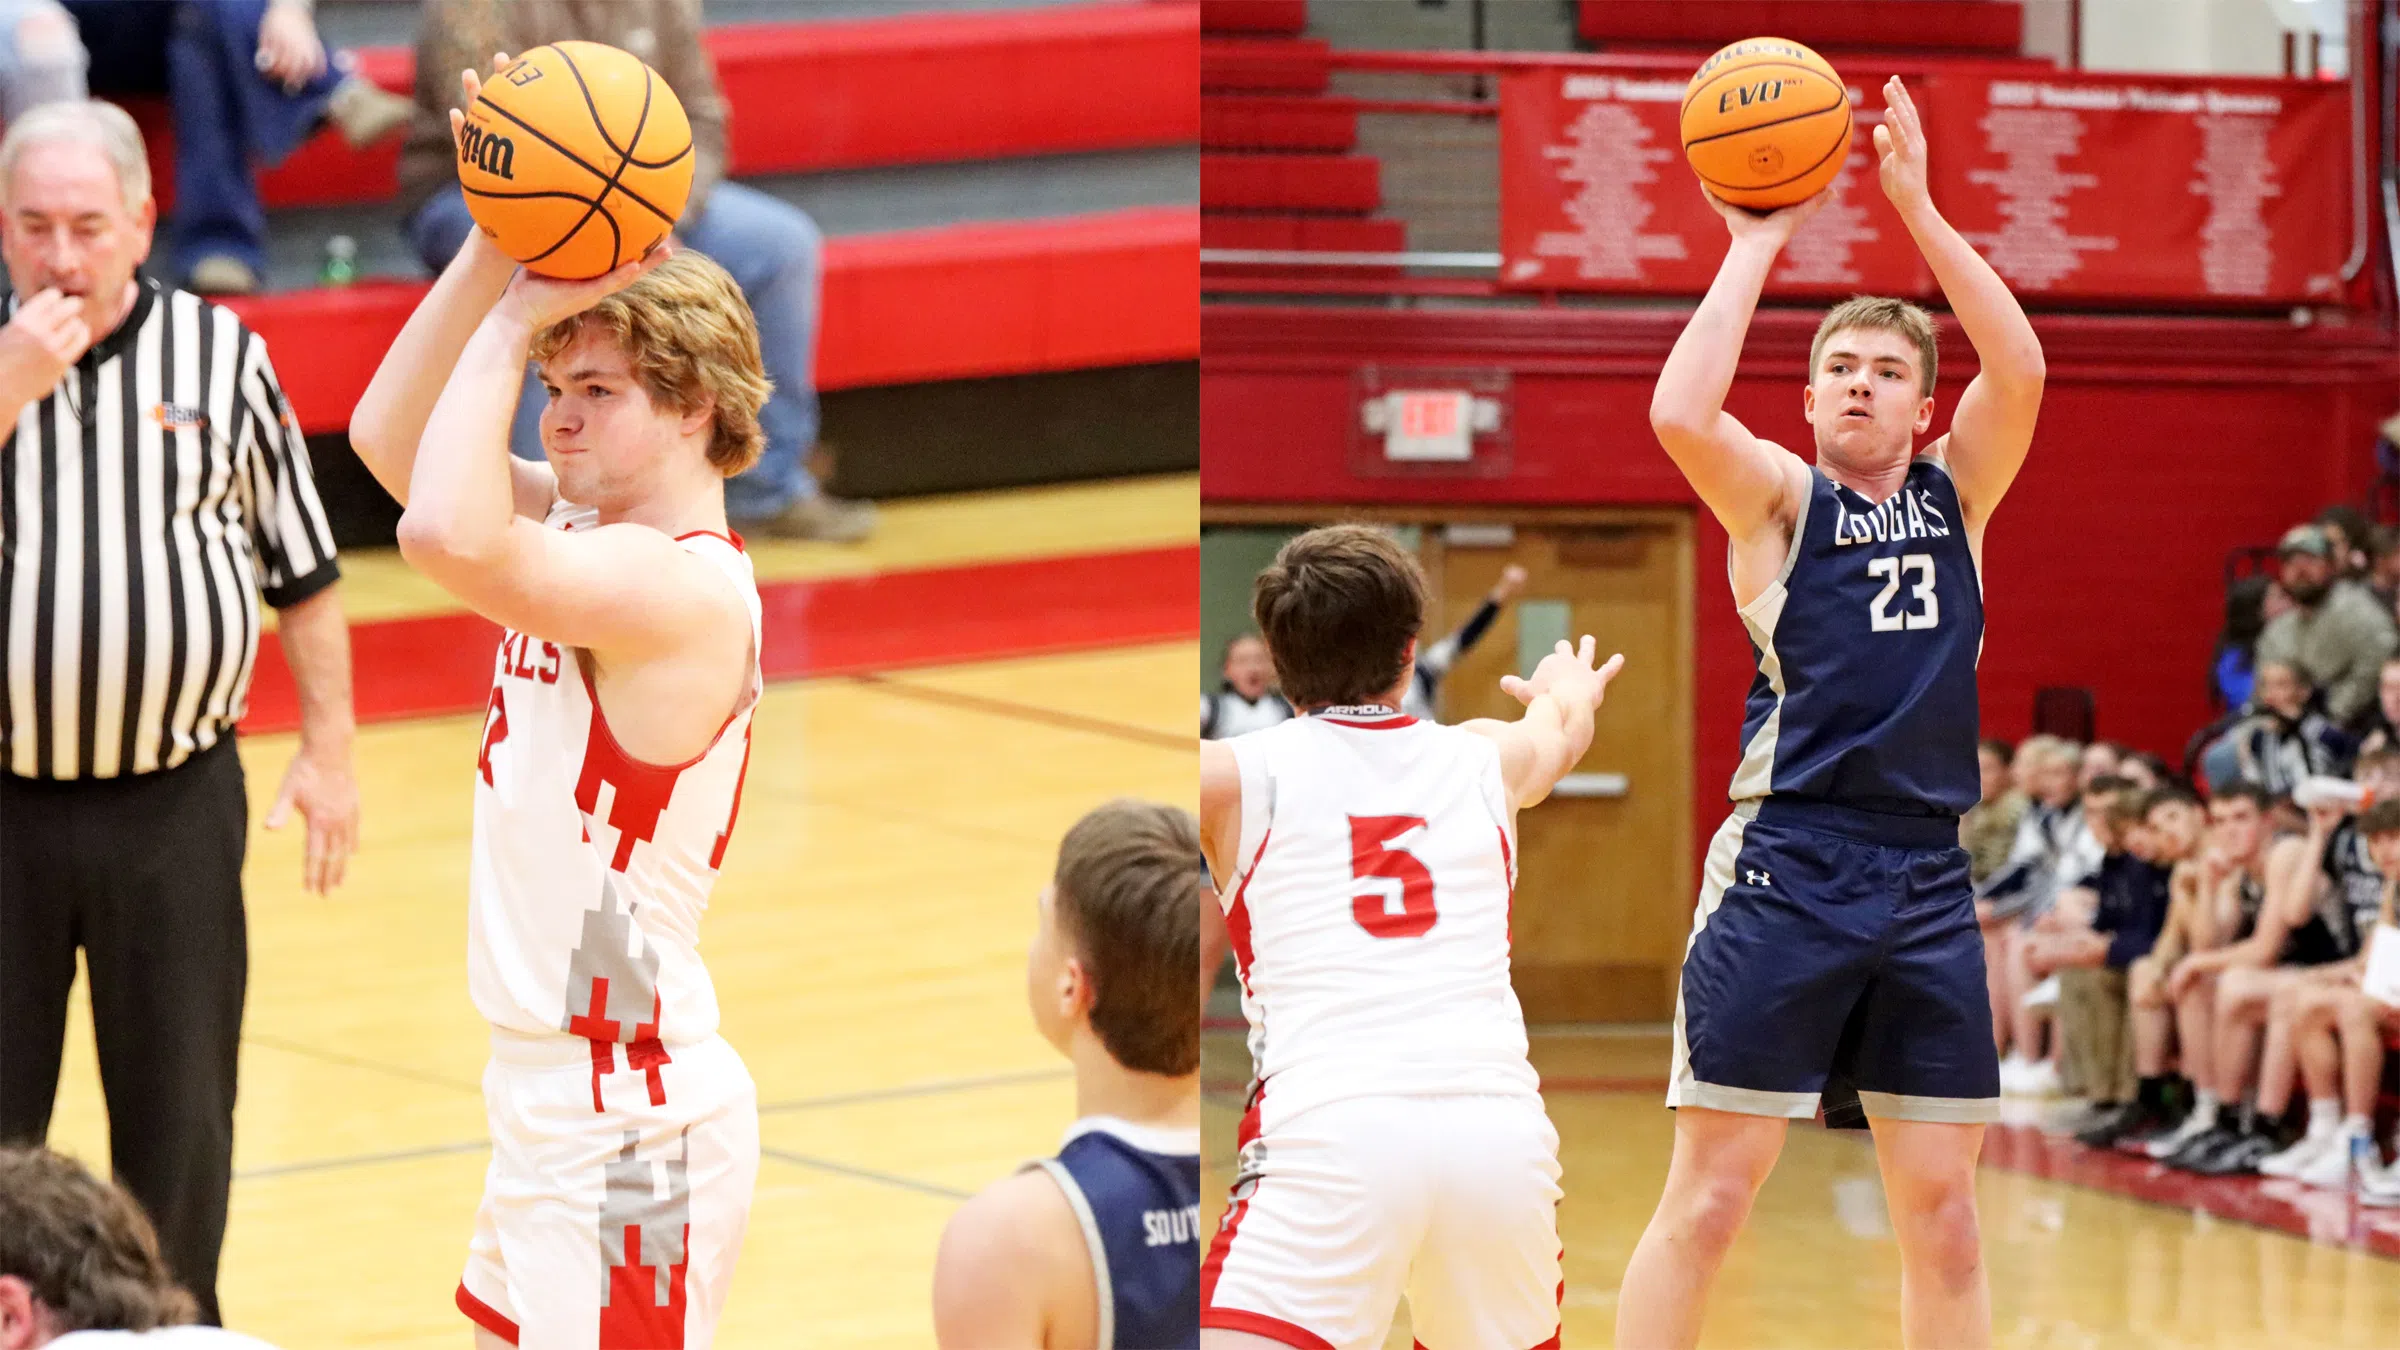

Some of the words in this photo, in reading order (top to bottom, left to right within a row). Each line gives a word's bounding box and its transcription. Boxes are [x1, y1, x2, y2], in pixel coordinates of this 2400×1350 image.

[1719, 79, 1783, 114] EVO
[1867, 553, 1939, 633] 23
[1345, 812, 1440, 939] 5
